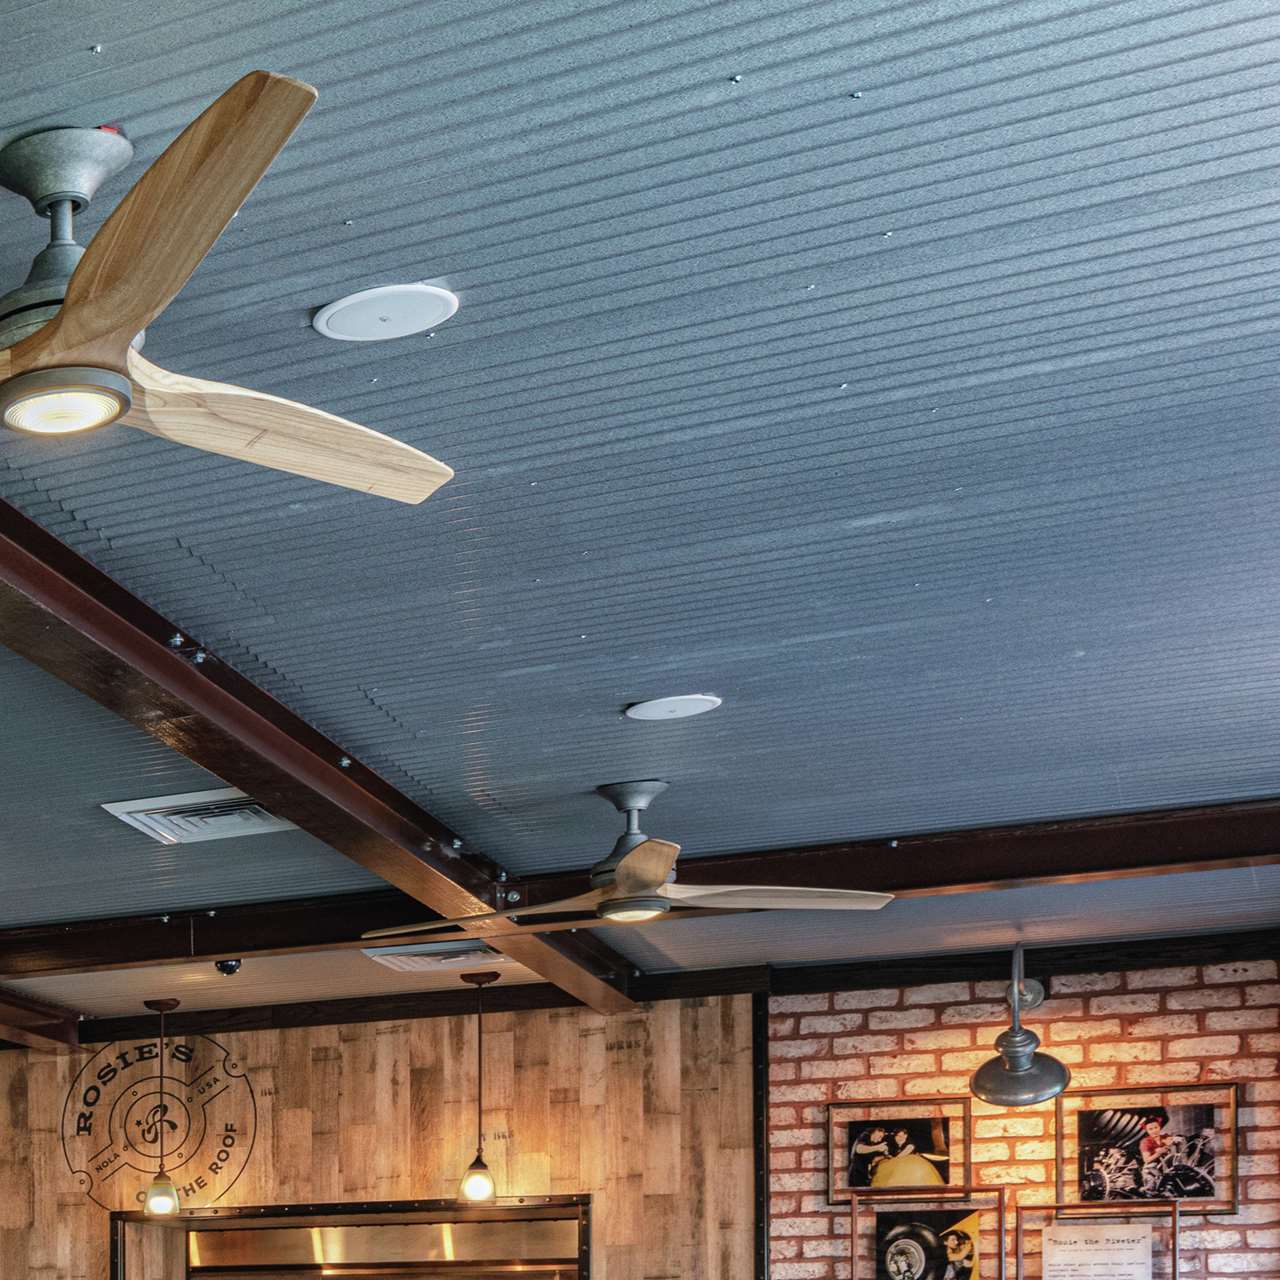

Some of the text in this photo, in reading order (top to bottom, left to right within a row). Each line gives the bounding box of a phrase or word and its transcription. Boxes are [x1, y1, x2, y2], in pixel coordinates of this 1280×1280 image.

[76, 1042, 193, 1137] ROSIE'S
[197, 1076, 221, 1095] USA
[95, 1152, 120, 1174] NOLA
[208, 1122, 238, 1176] ROOF
